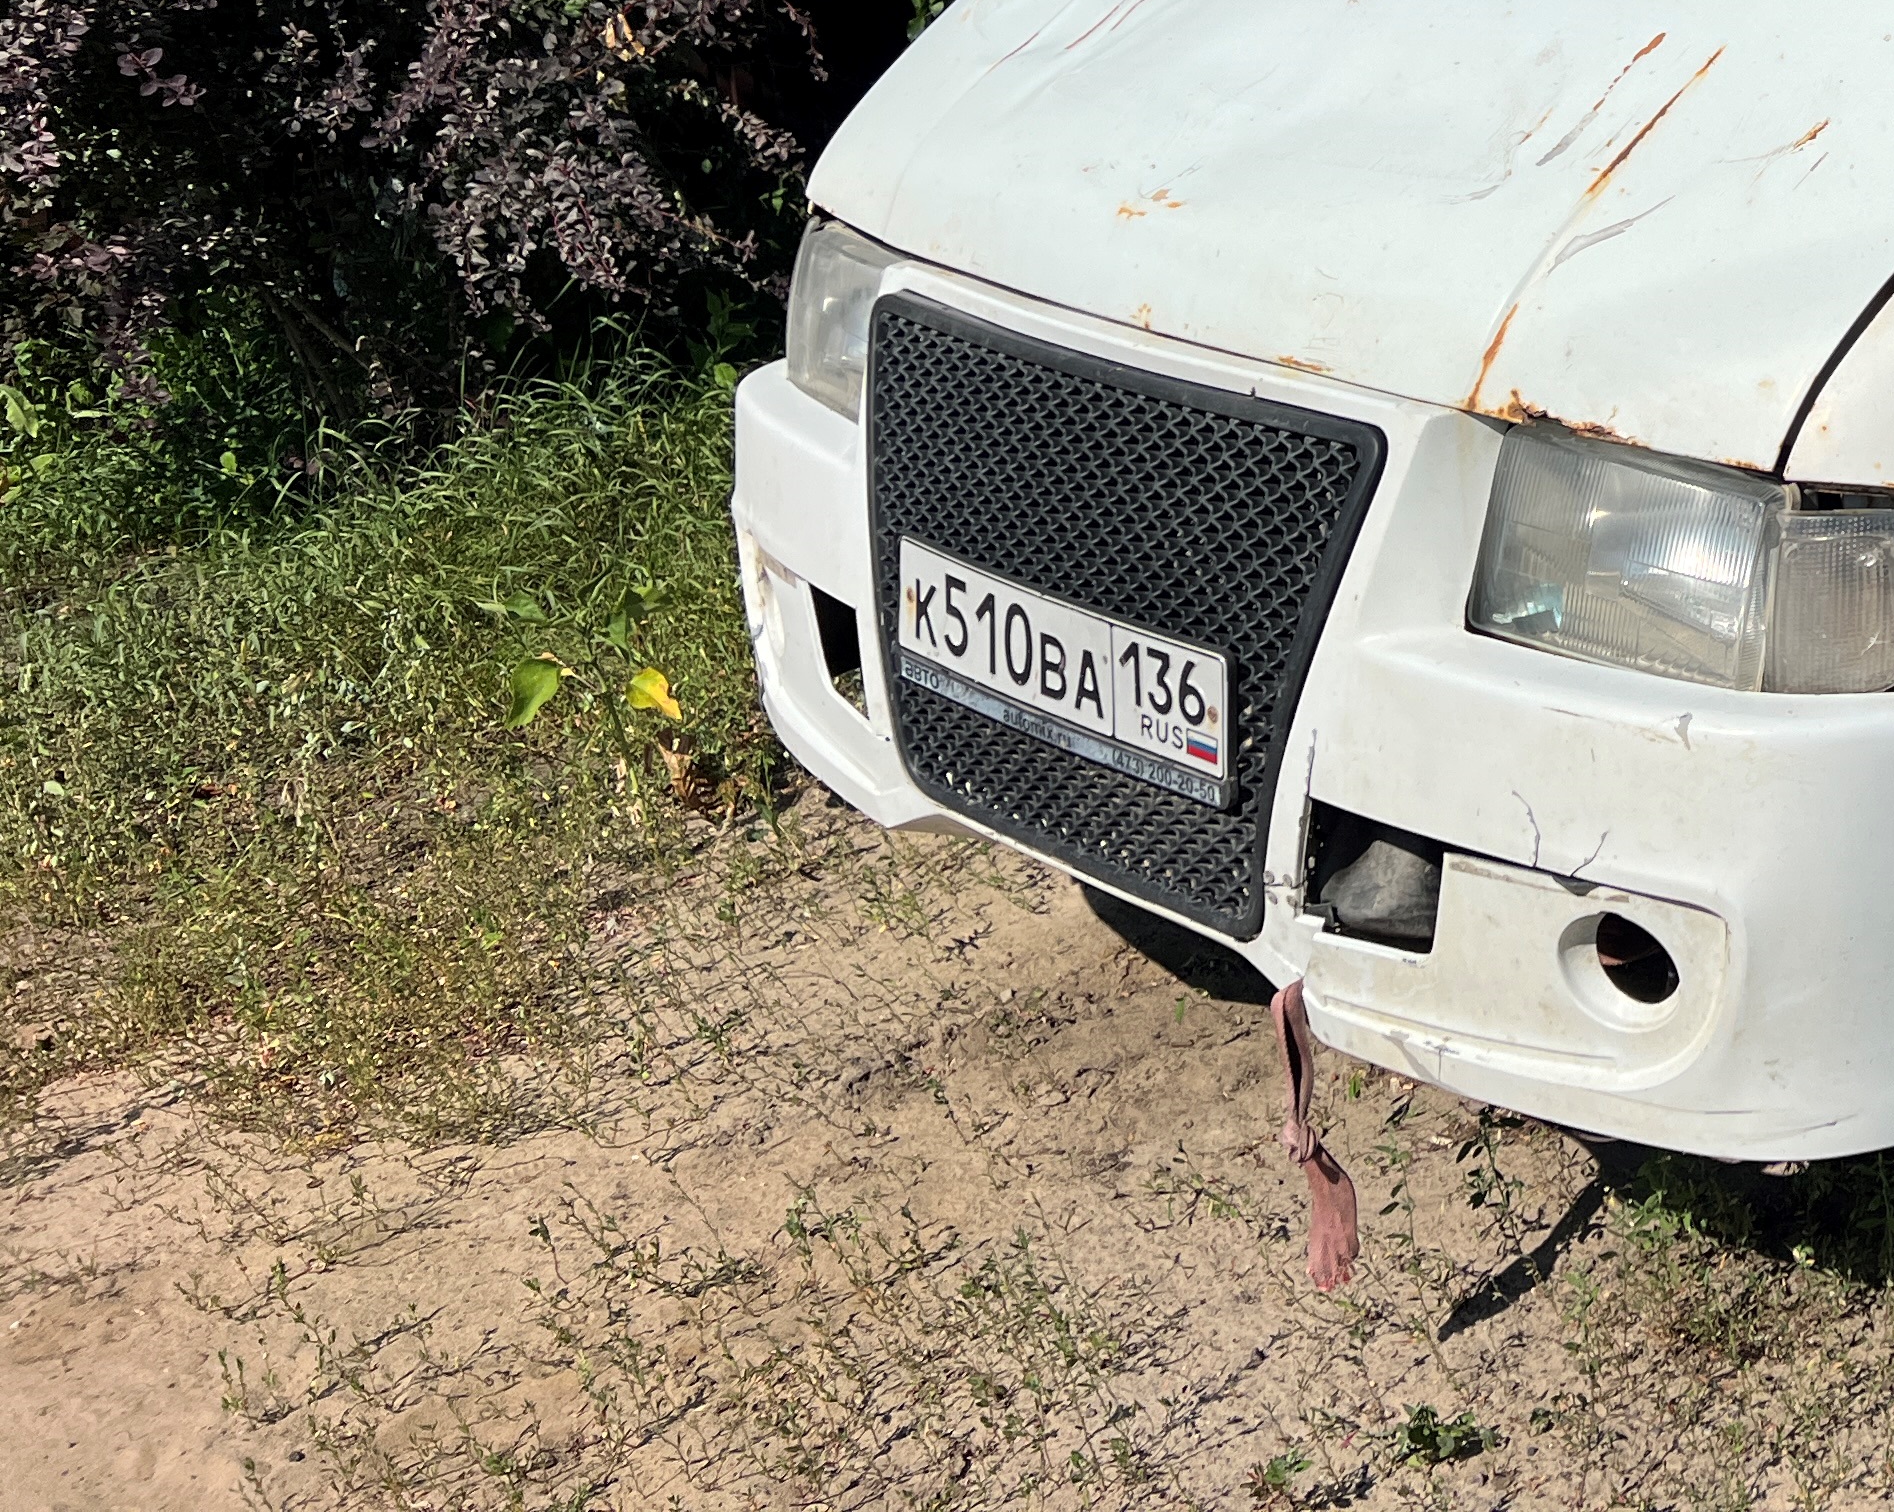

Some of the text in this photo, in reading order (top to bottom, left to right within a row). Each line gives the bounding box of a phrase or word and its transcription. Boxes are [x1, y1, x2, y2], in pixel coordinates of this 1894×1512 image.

[914, 572, 1206, 726] К510ВА 136
[1002, 707, 1217, 803] automix.ru (473) 200-20-50
[1140, 713, 1184, 751] RUS
